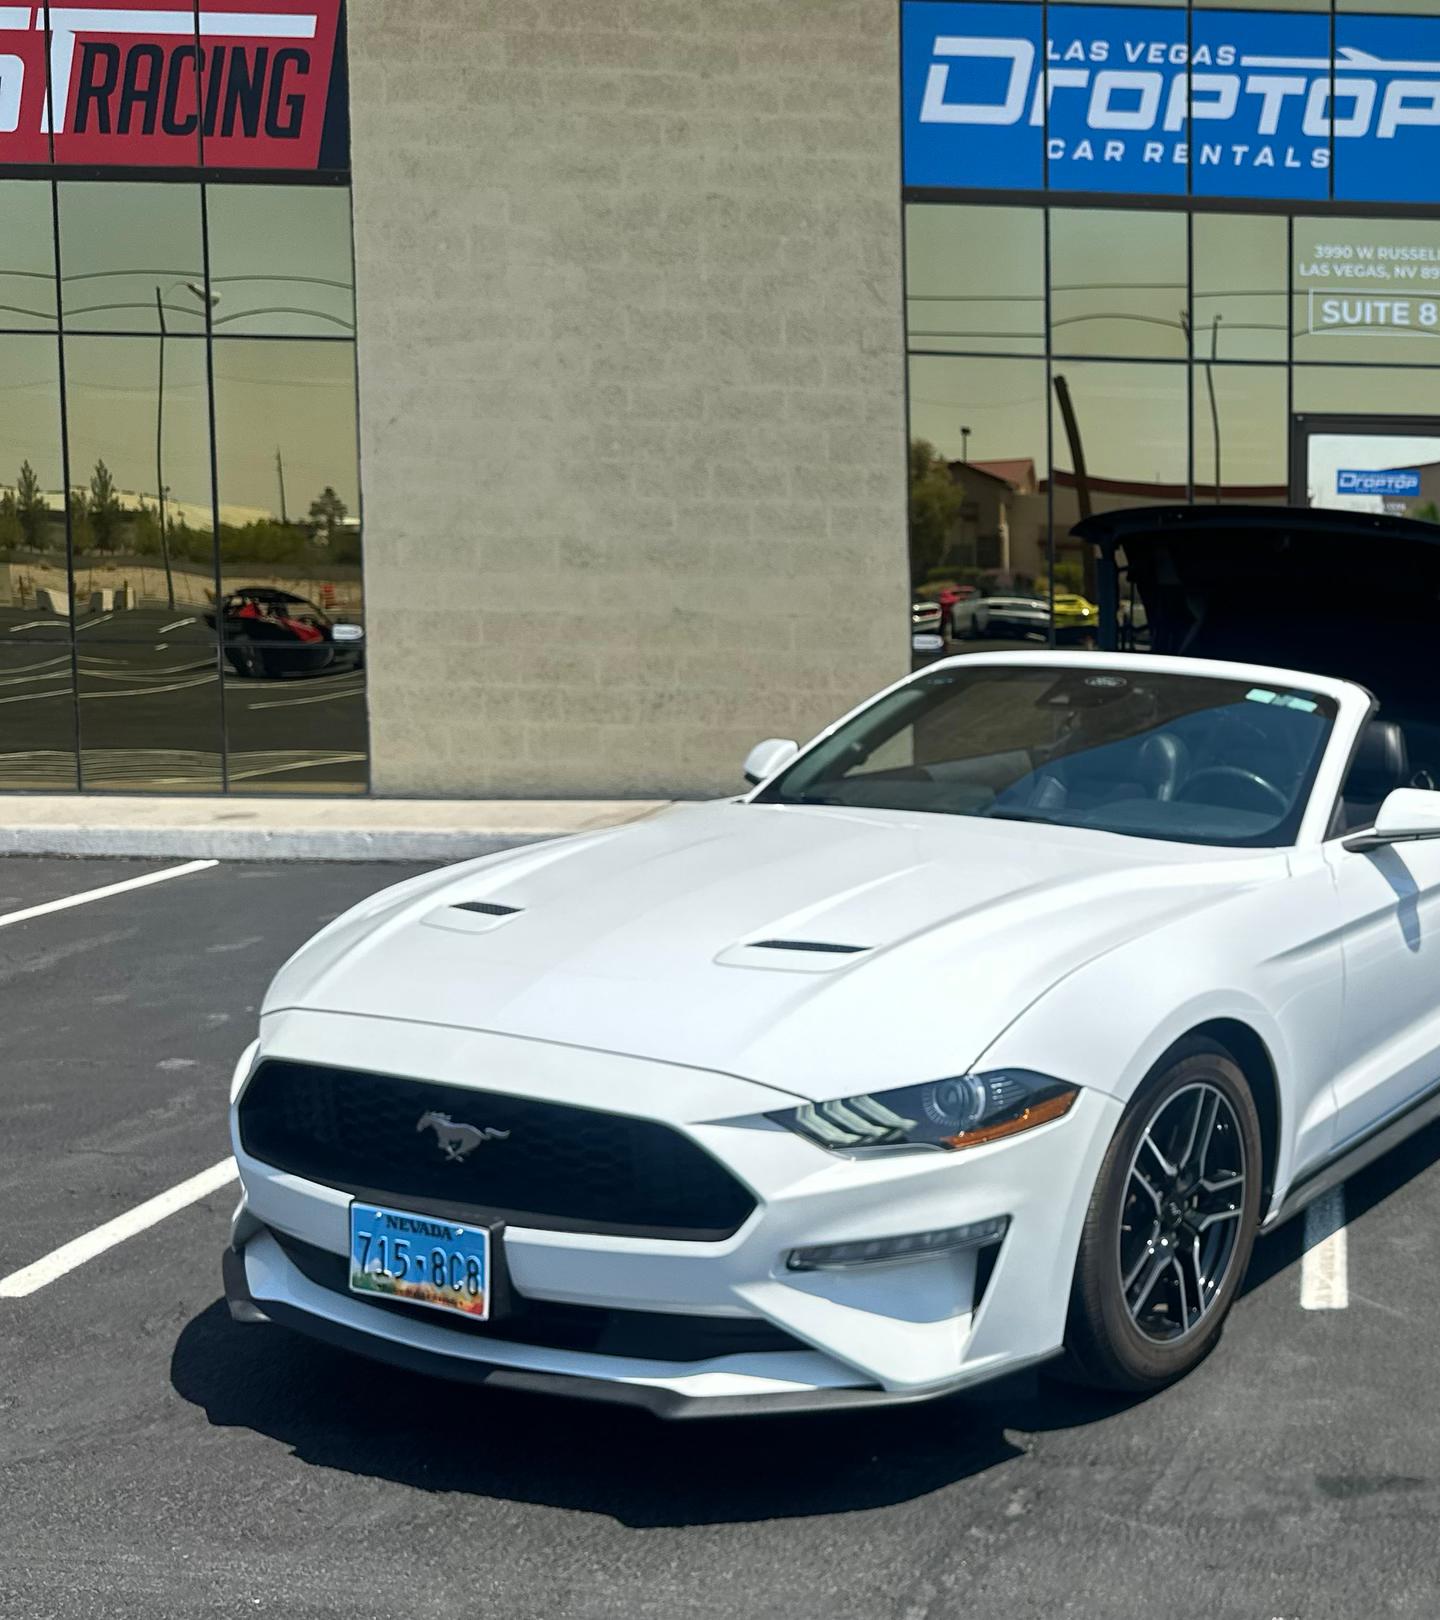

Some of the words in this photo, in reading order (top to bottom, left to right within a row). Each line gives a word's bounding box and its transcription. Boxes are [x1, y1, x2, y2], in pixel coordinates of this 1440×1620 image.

[1046, 40, 1110, 62] LAS
[1124, 41, 1237, 66] VEGAS
[73, 42, 311, 139] RACING
[1047, 139, 1125, 163] CAR
[1143, 143, 1332, 168] RENTALS
[1357, 246, 1375, 260] W
[1300, 263, 1330, 277] LAS
[1333, 265, 1391, 280] VEGAS,
[1394, 266, 1417, 279] NV
[1322, 300, 1411, 325] SUITE
[1418, 303, 1438, 326] 8
[387, 1215, 452, 1240] NEVADA
